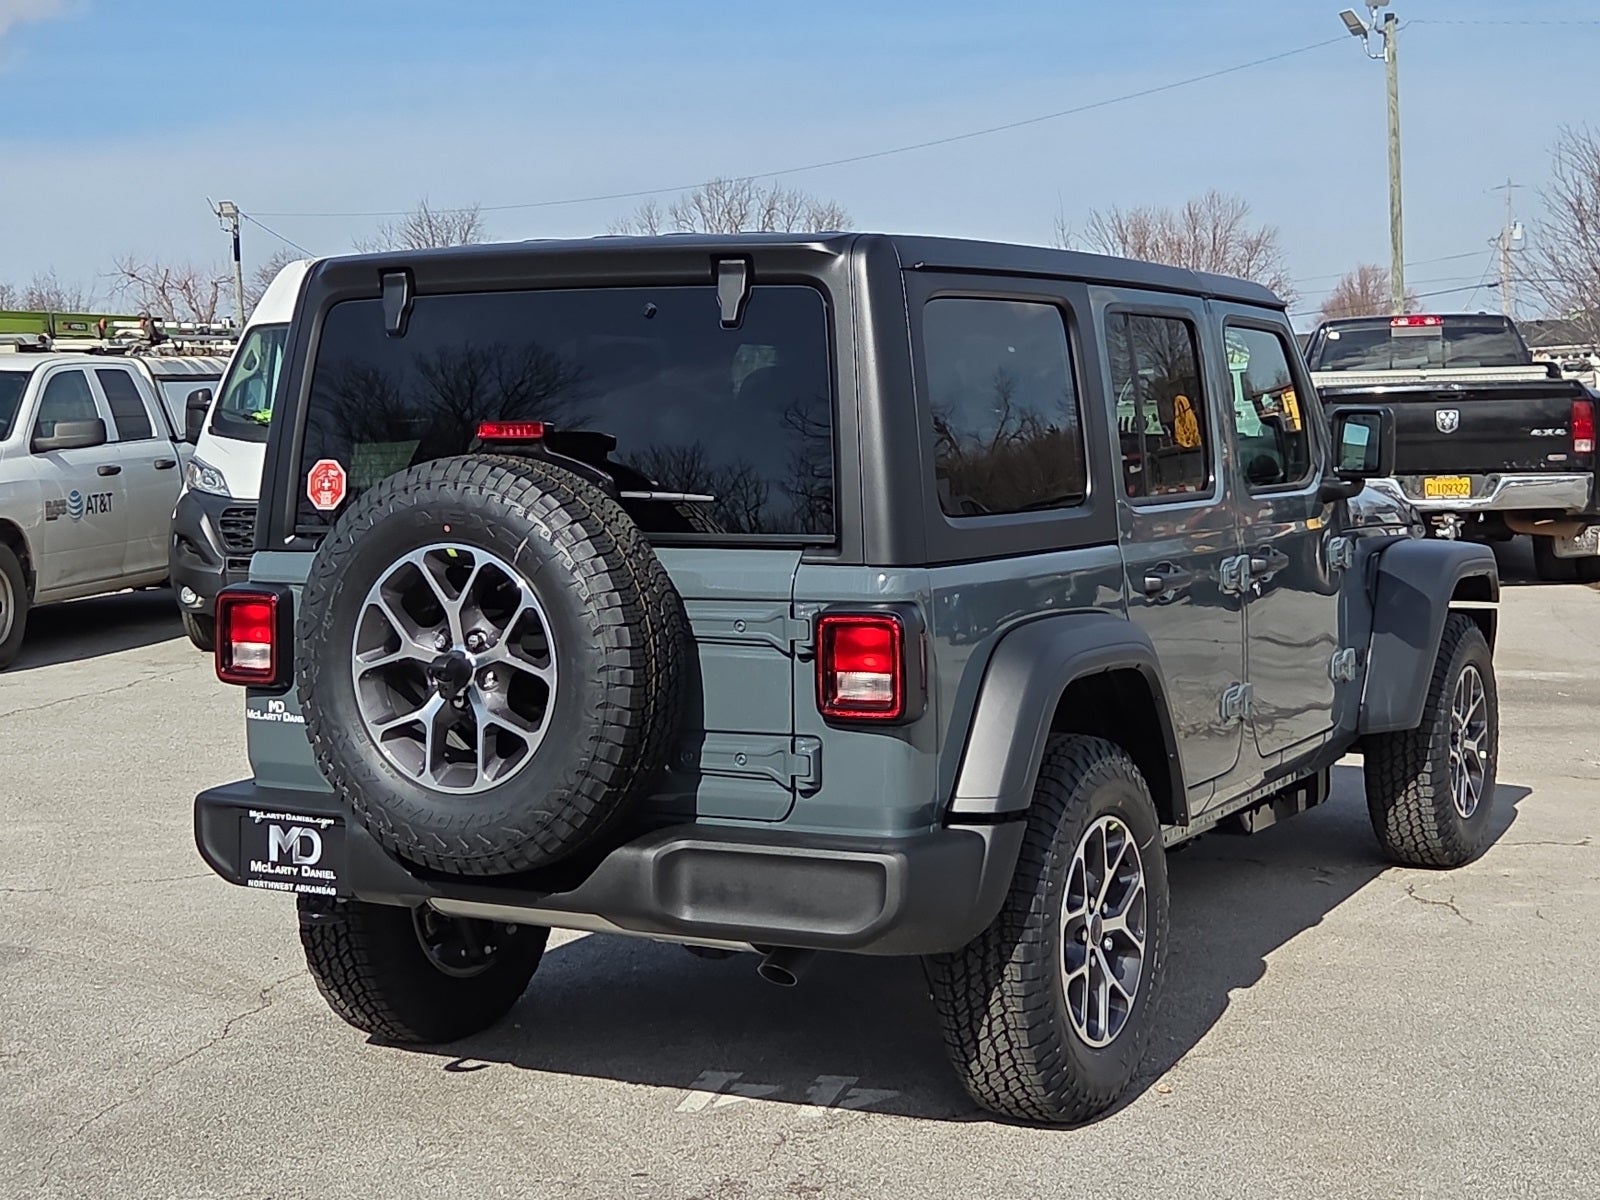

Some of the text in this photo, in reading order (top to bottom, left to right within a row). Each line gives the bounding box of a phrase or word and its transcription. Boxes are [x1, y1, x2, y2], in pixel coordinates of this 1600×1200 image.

[86, 492, 113, 516] AT&T
[268, 700, 285, 713] MD
[268, 824, 322, 866] MD
[302, 865, 336, 880] DANIEL
[248, 879, 336, 896] NORTHWEST ARKANSAS
